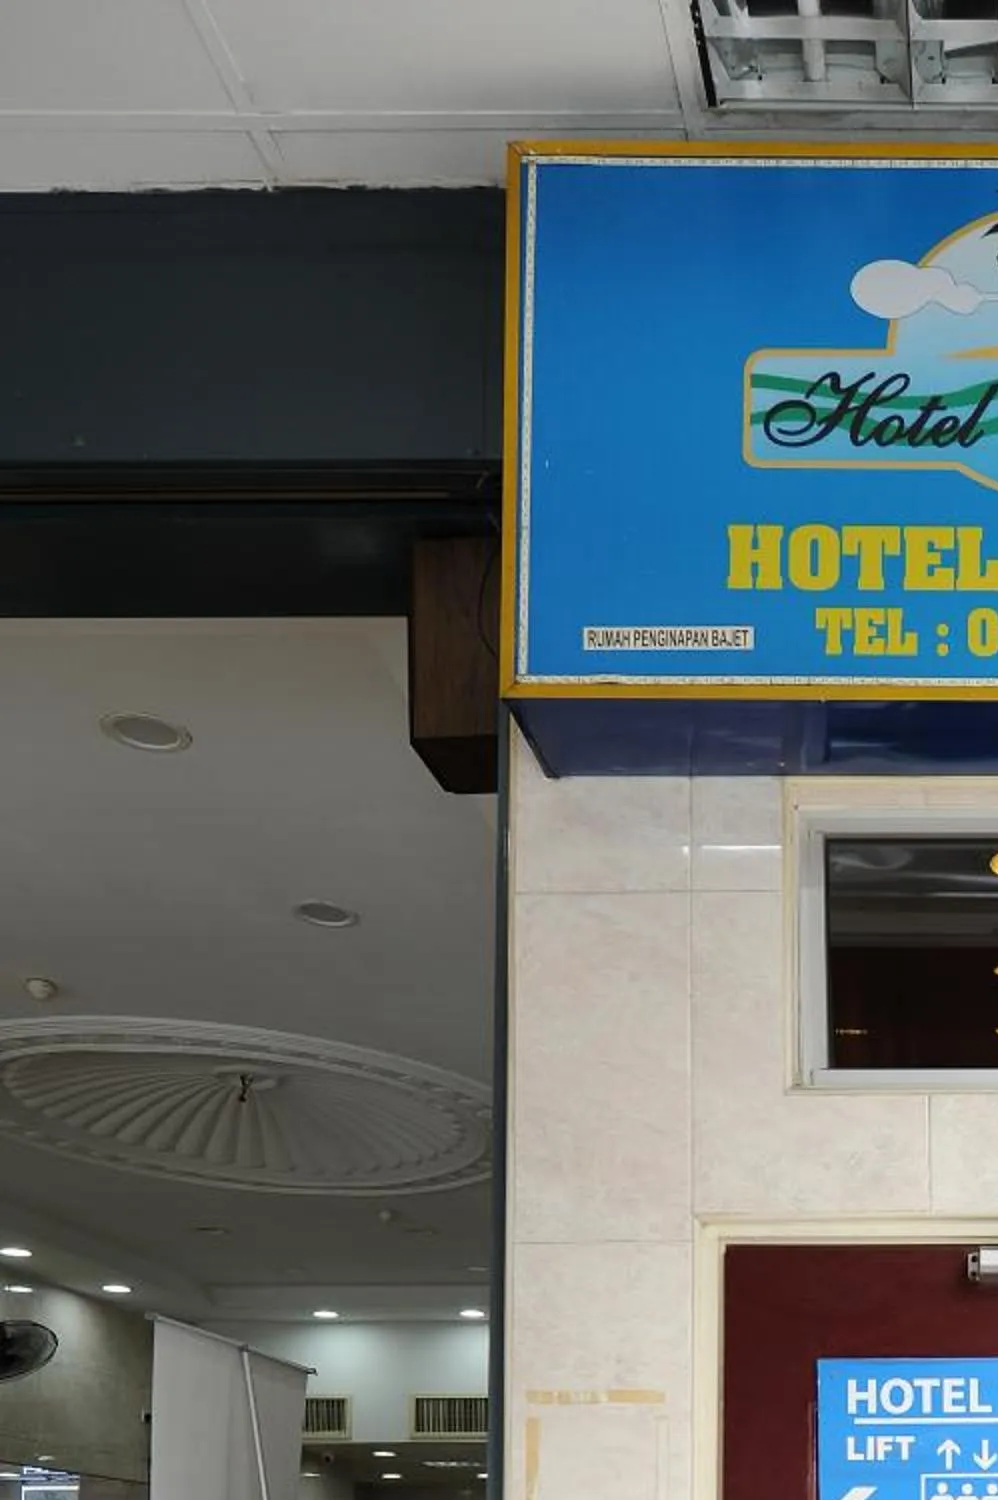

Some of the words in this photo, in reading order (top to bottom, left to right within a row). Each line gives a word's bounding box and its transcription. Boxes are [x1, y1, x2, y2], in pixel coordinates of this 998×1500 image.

[588, 630, 630, 647] RUMAH
[633, 629, 709, 647] PENGINAPAN
[711, 629, 749, 647] BAJET
[847, 1378, 993, 1415] HOTEL
[846, 1435, 916, 1461] LIFT
